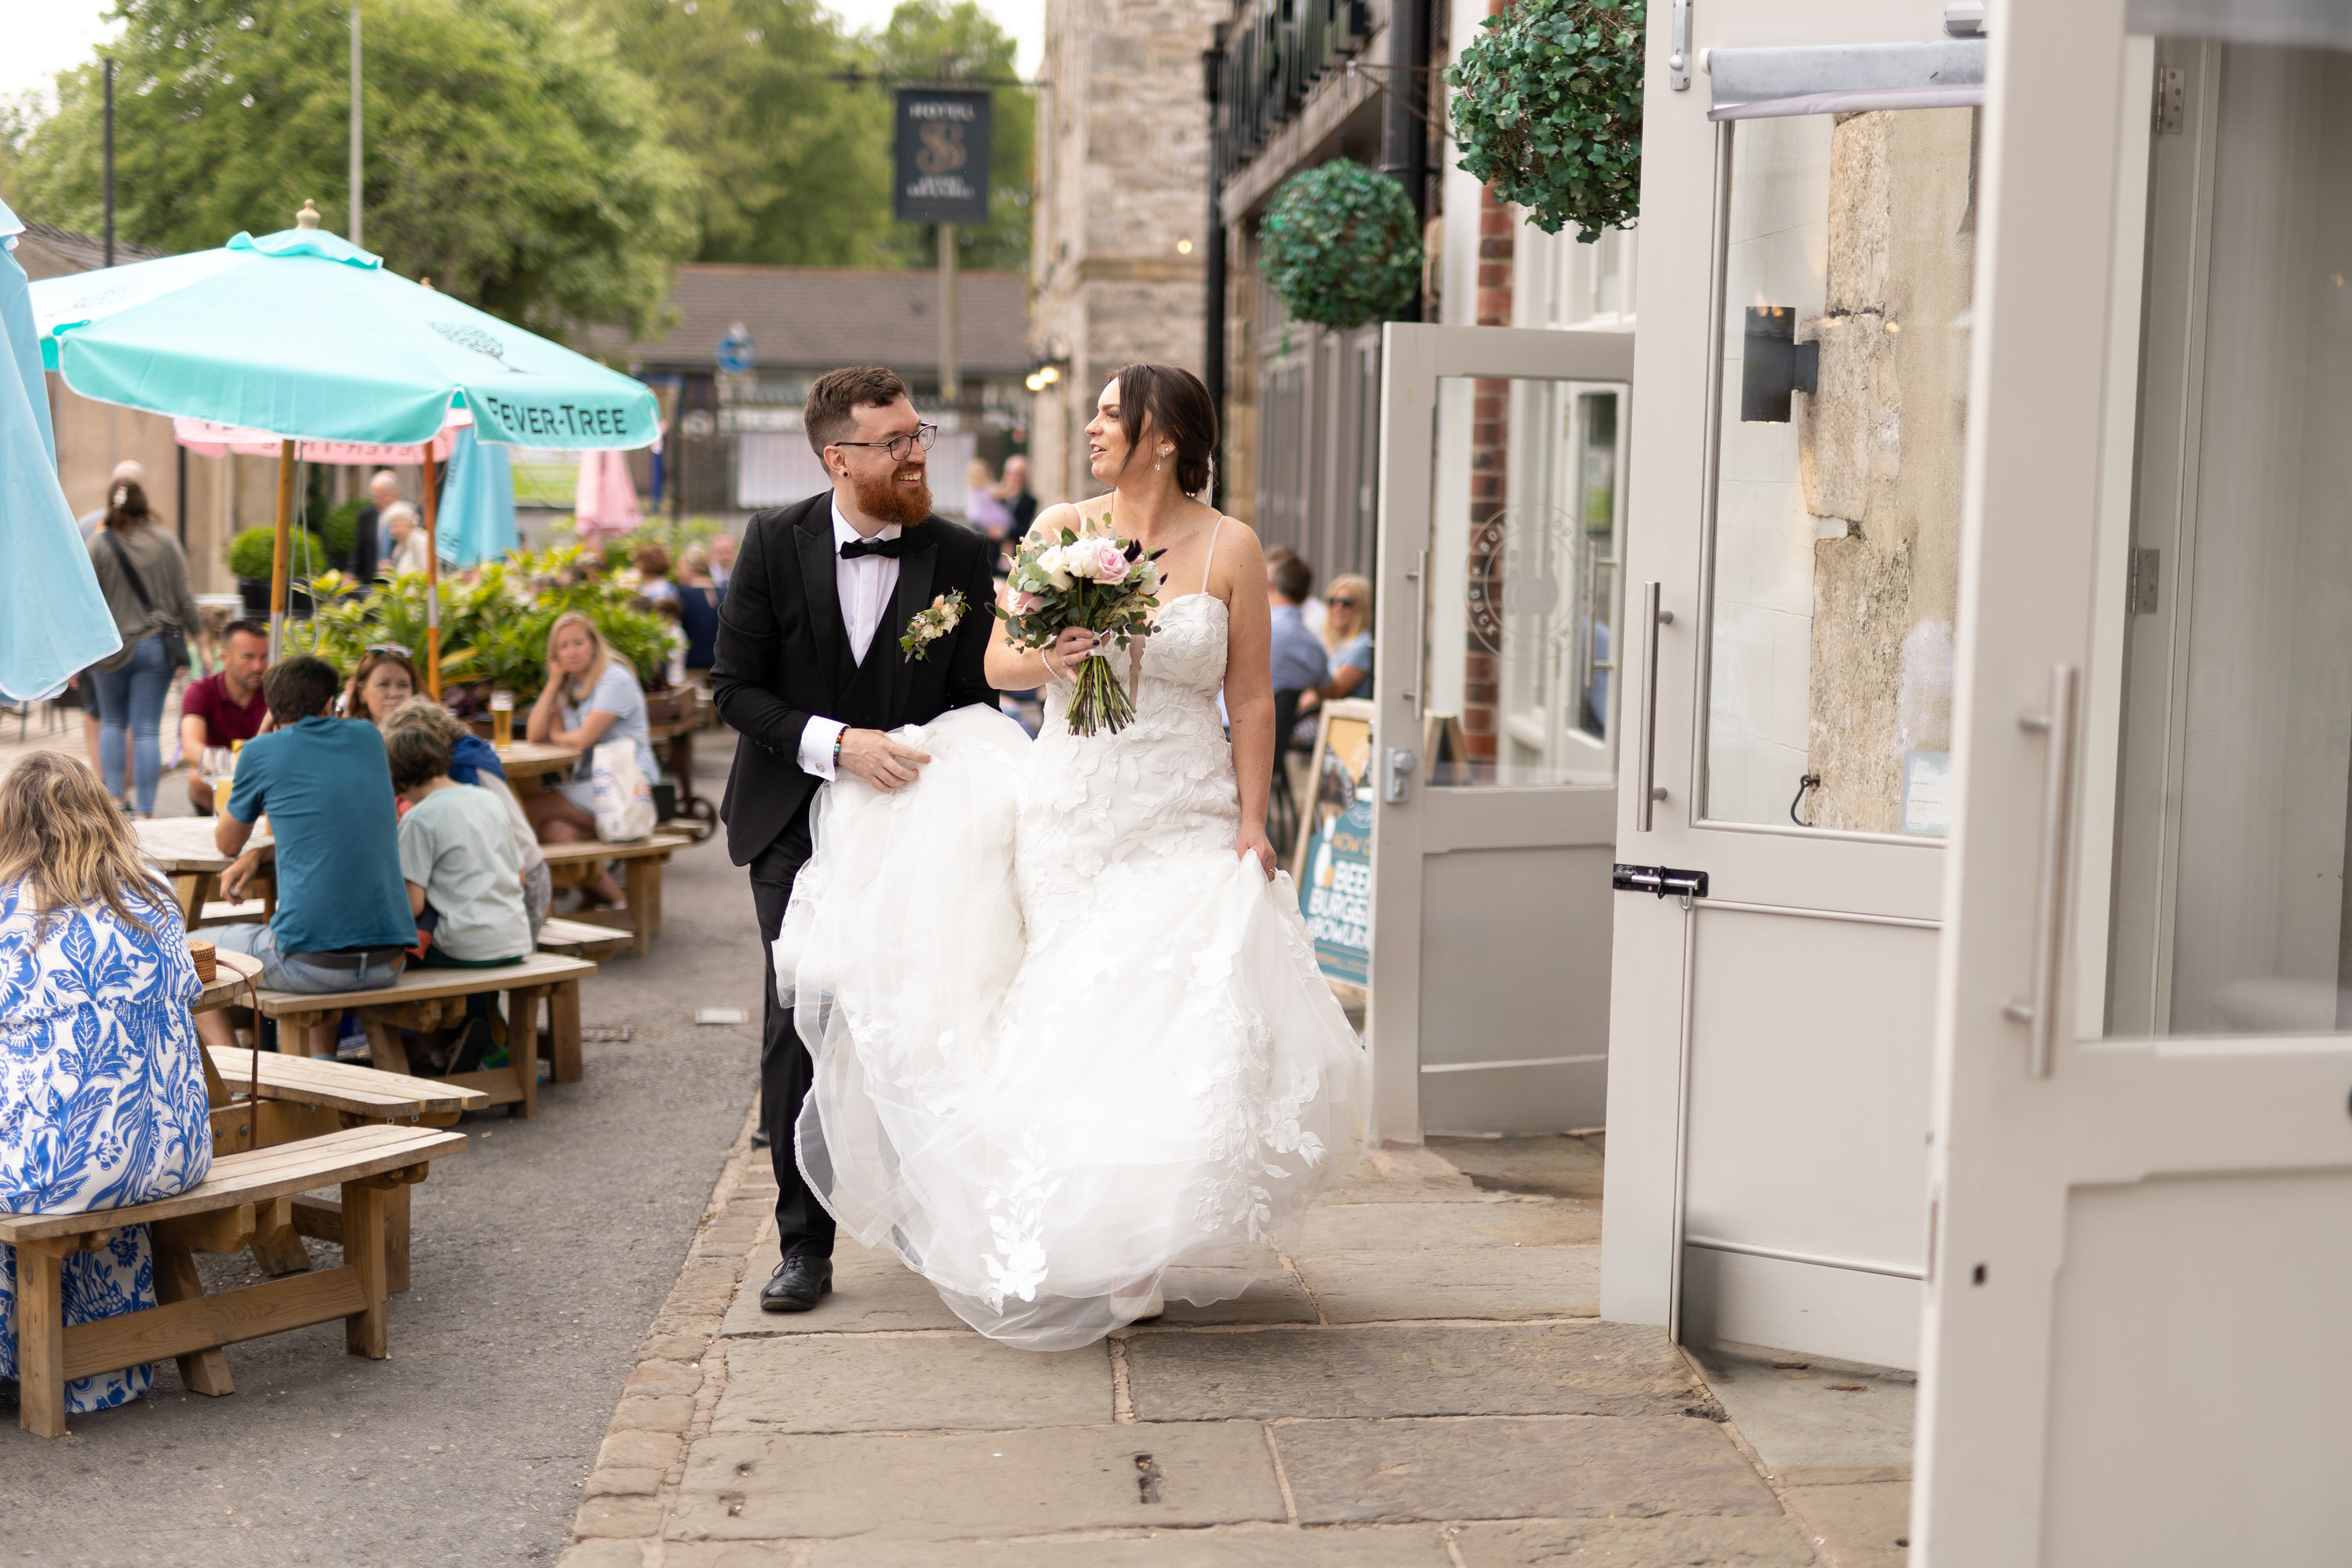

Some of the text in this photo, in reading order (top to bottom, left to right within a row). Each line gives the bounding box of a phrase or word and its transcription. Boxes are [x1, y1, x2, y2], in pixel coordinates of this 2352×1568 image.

[1333, 833, 1363, 854] NOW
[1333, 859, 1371, 896] BEE
[1308, 887, 1368, 927] BURGE
